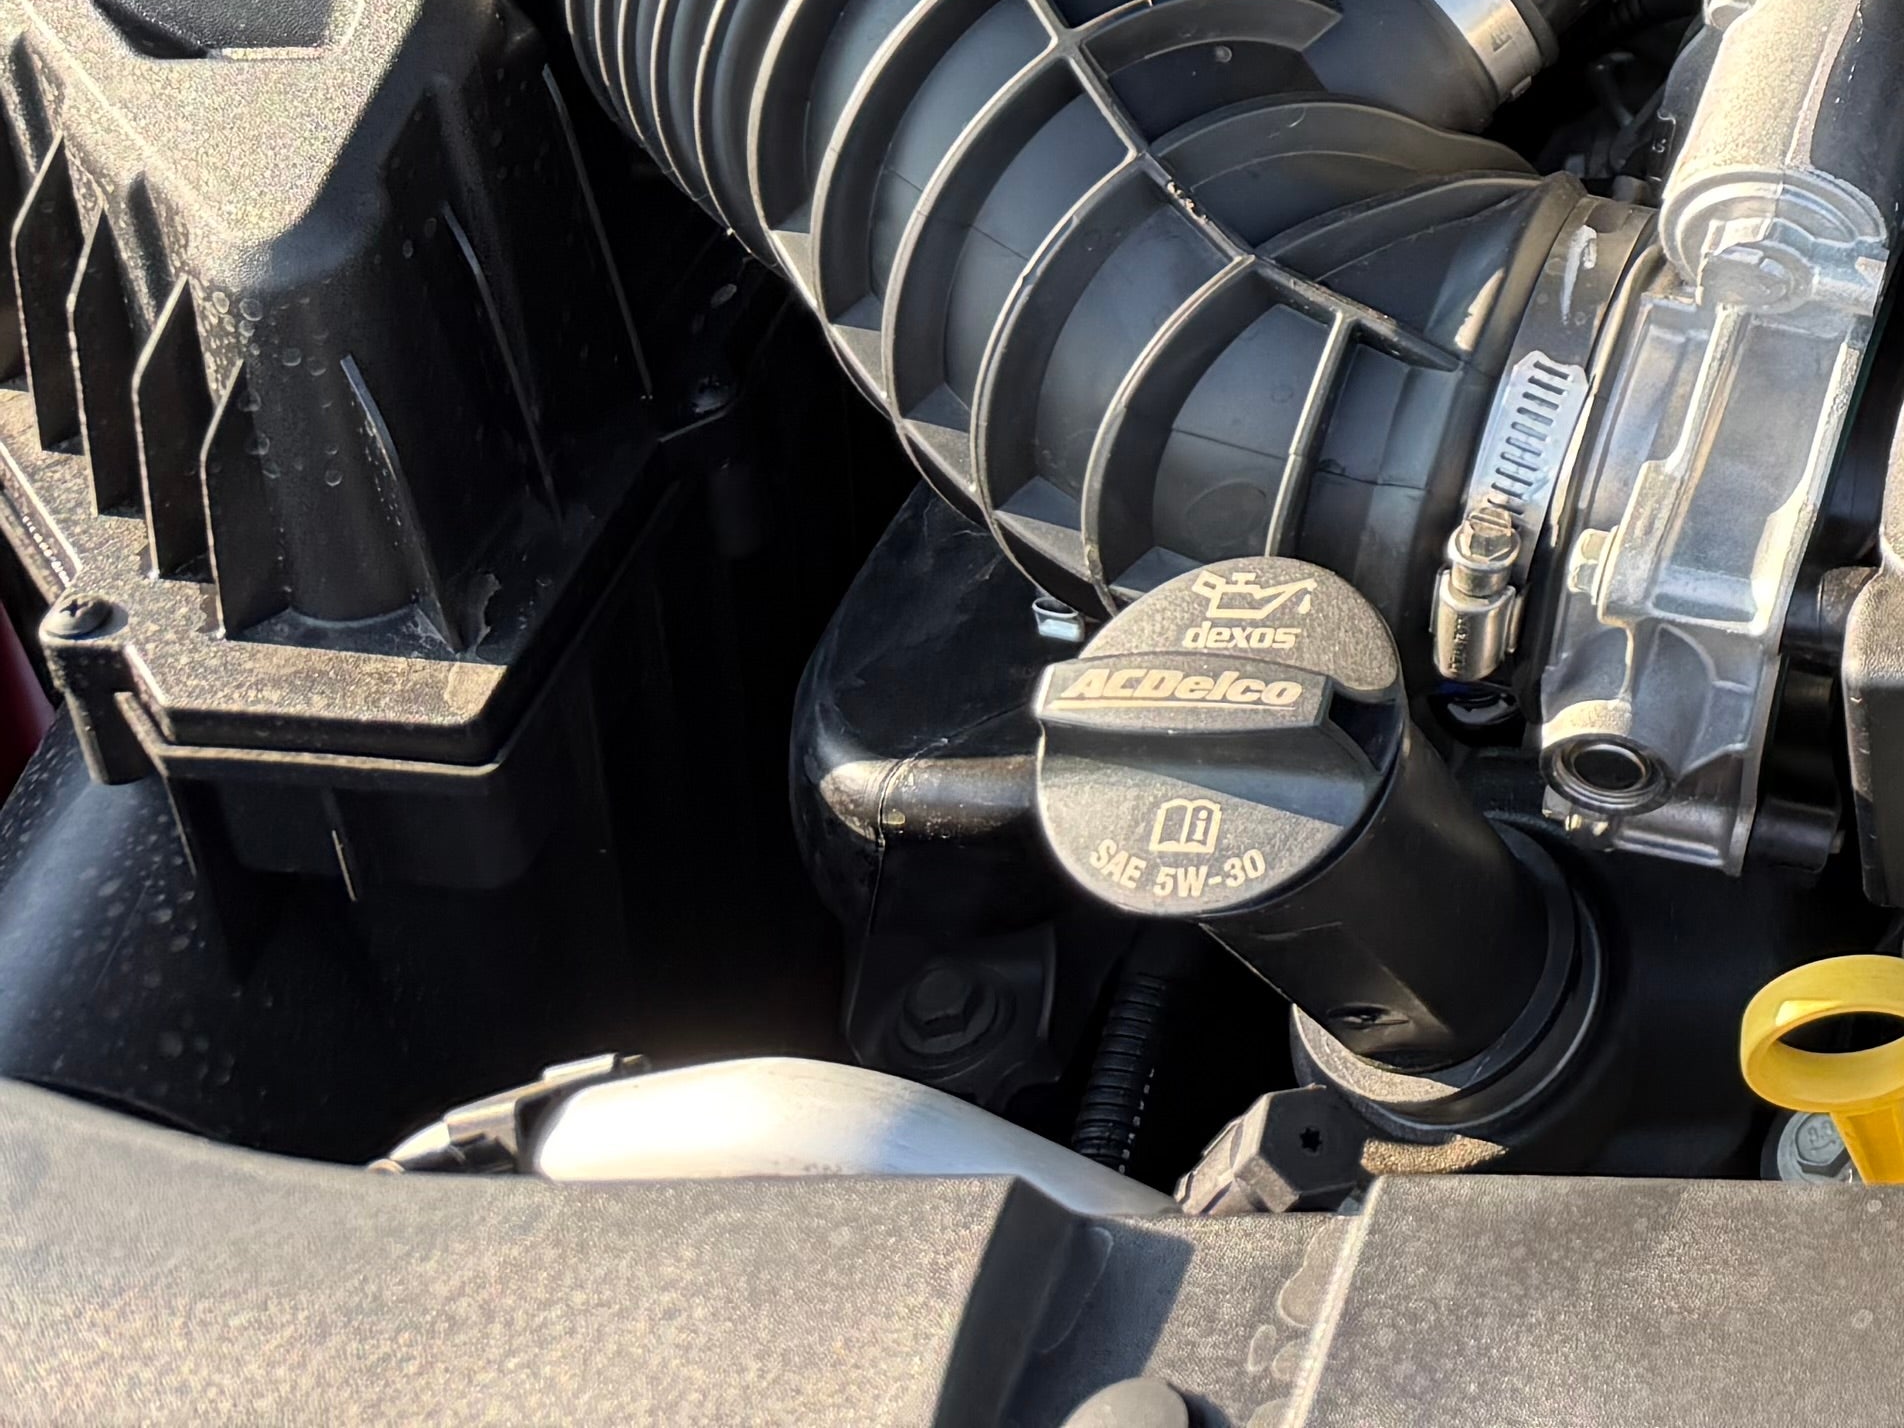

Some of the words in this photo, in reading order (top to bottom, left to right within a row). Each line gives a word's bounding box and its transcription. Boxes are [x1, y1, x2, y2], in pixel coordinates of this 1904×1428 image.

[1182, 621, 1302, 650] dexos
[1060, 667, 1303, 706] ACDelco
[1090, 839, 1147, 888] SAE
[1153, 849, 1267, 897] 5W-30
